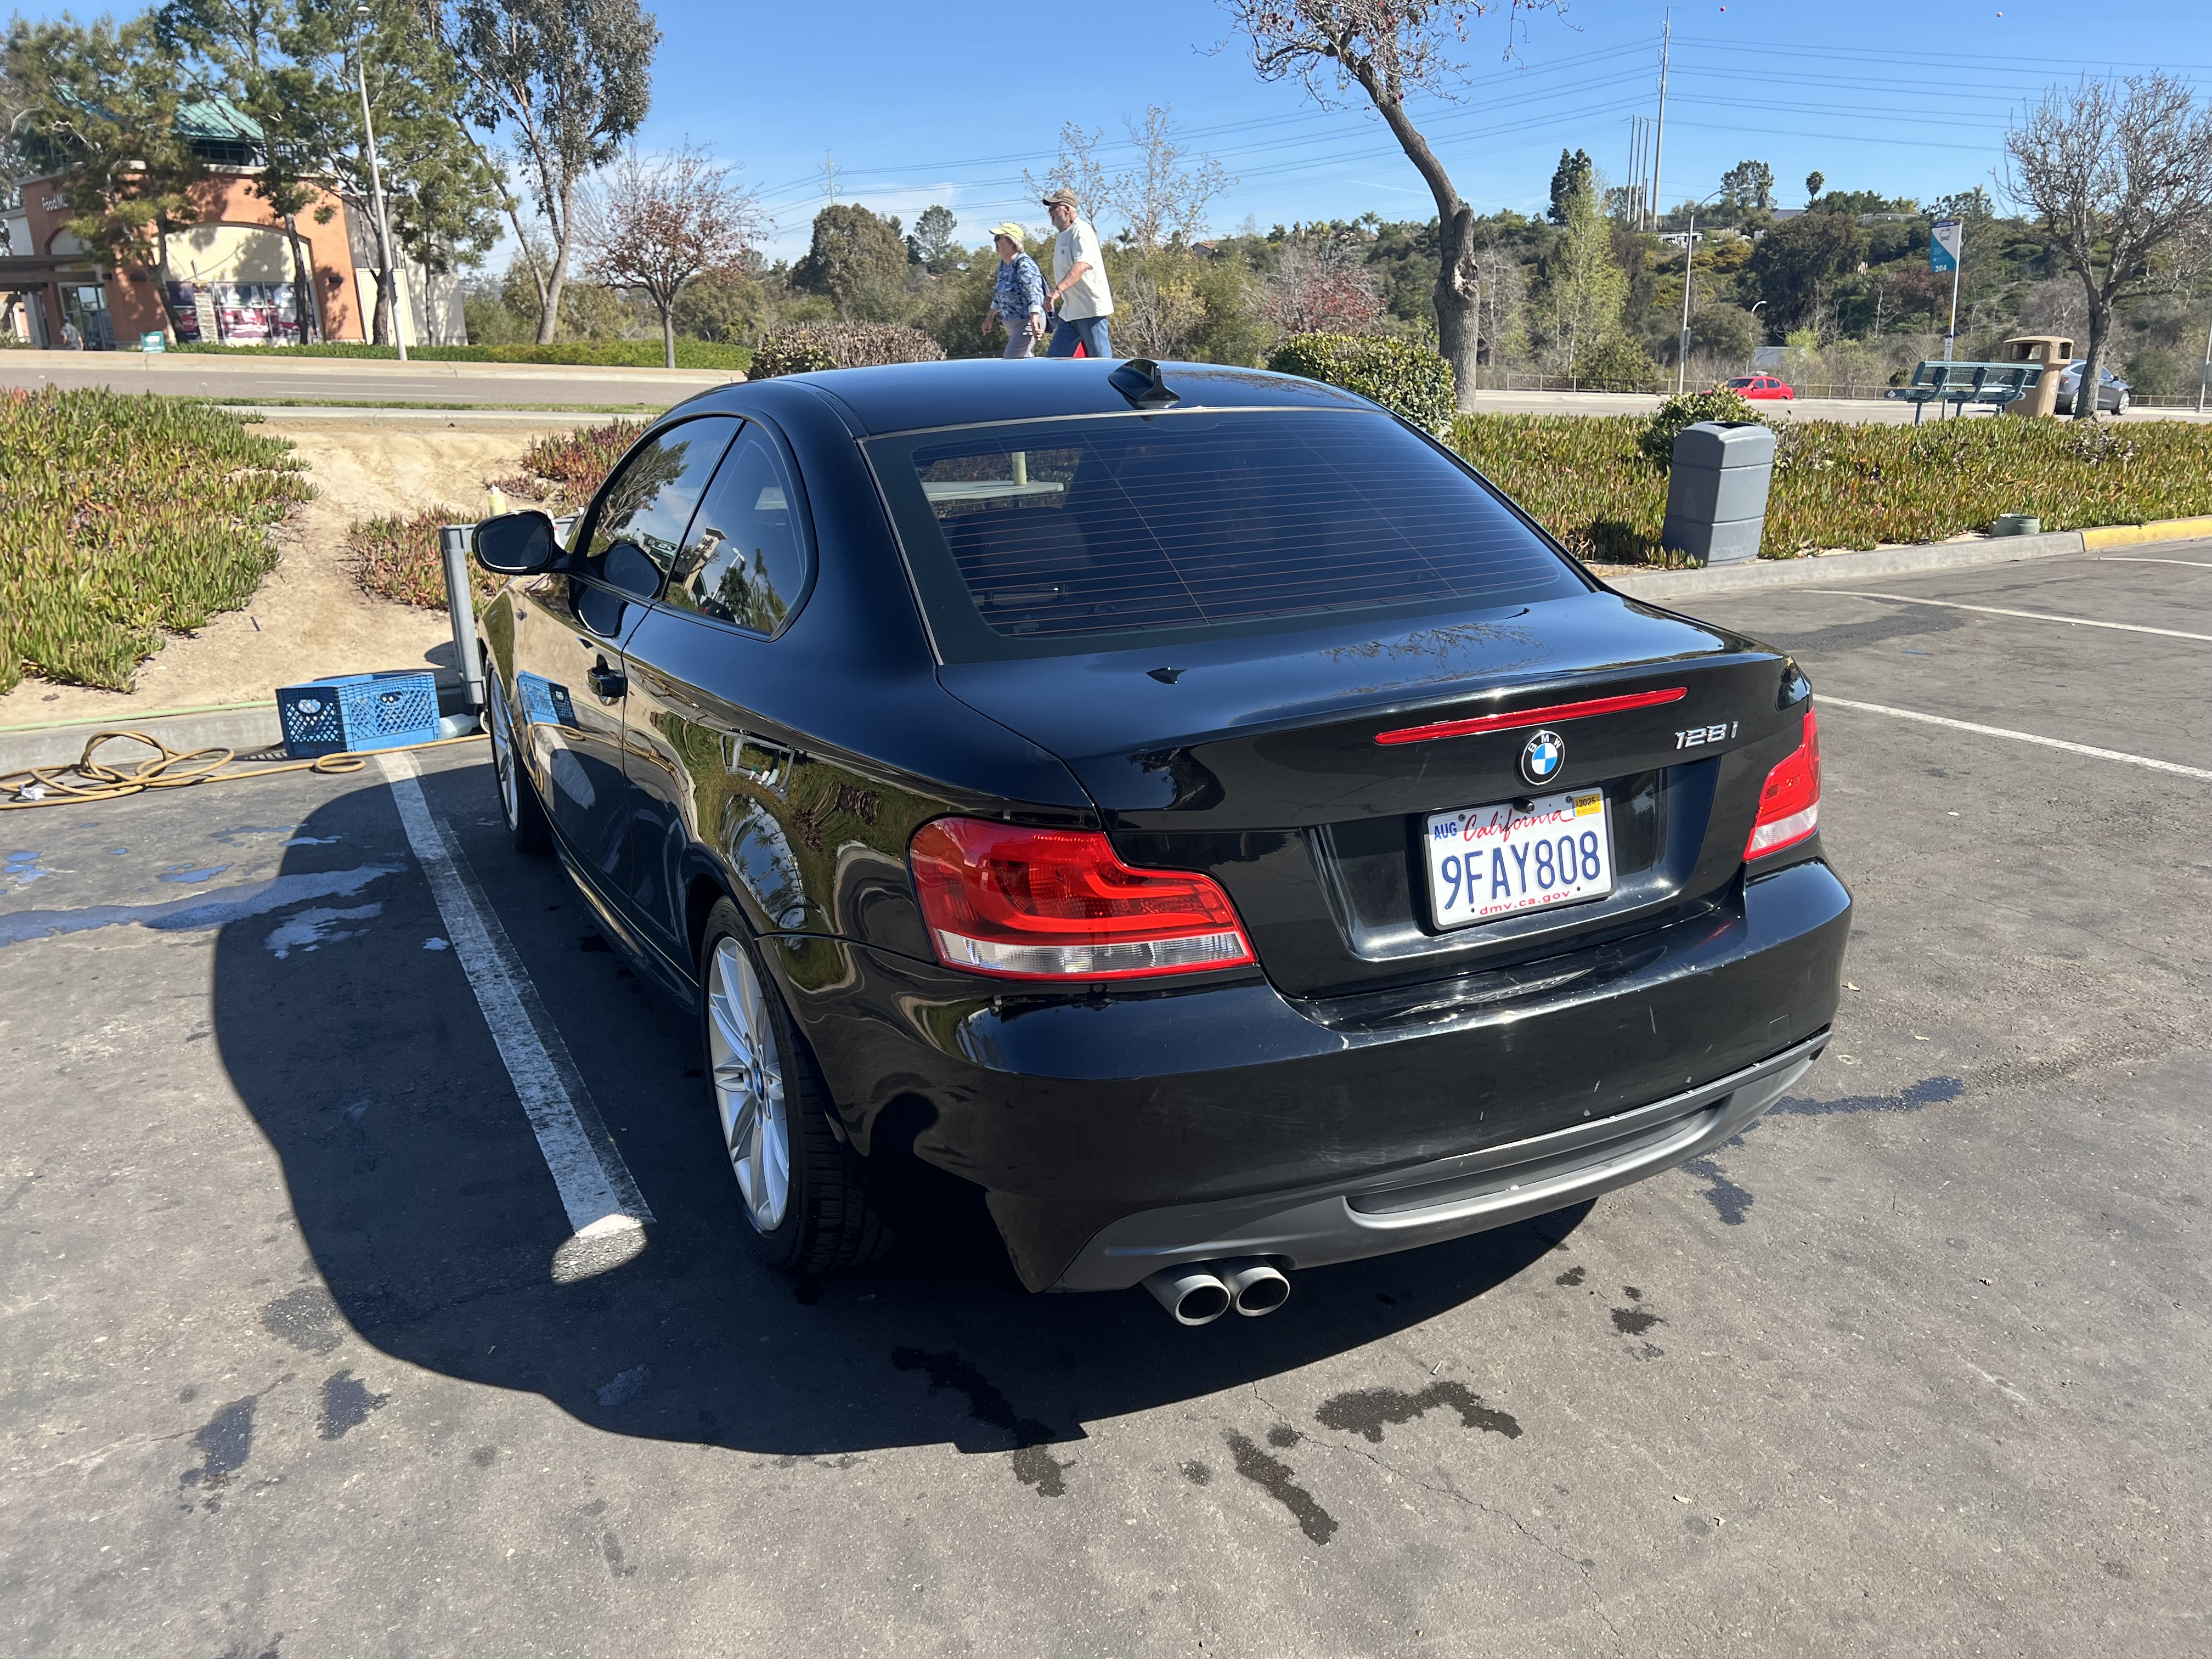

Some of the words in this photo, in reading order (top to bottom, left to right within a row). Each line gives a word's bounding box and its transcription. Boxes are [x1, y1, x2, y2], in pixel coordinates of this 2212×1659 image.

[41, 193, 58, 211] Food
[1528, 734, 1562, 753] BMW
[1674, 720, 1739, 749] 128i
[1579, 797, 1596, 807] 2025
[1434, 821, 1457, 841] AUG
[1463, 809, 1575, 843] California
[1441, 830, 1601, 910] 9FAY808
[1480, 890, 1570, 915] dmv.ca.gov
